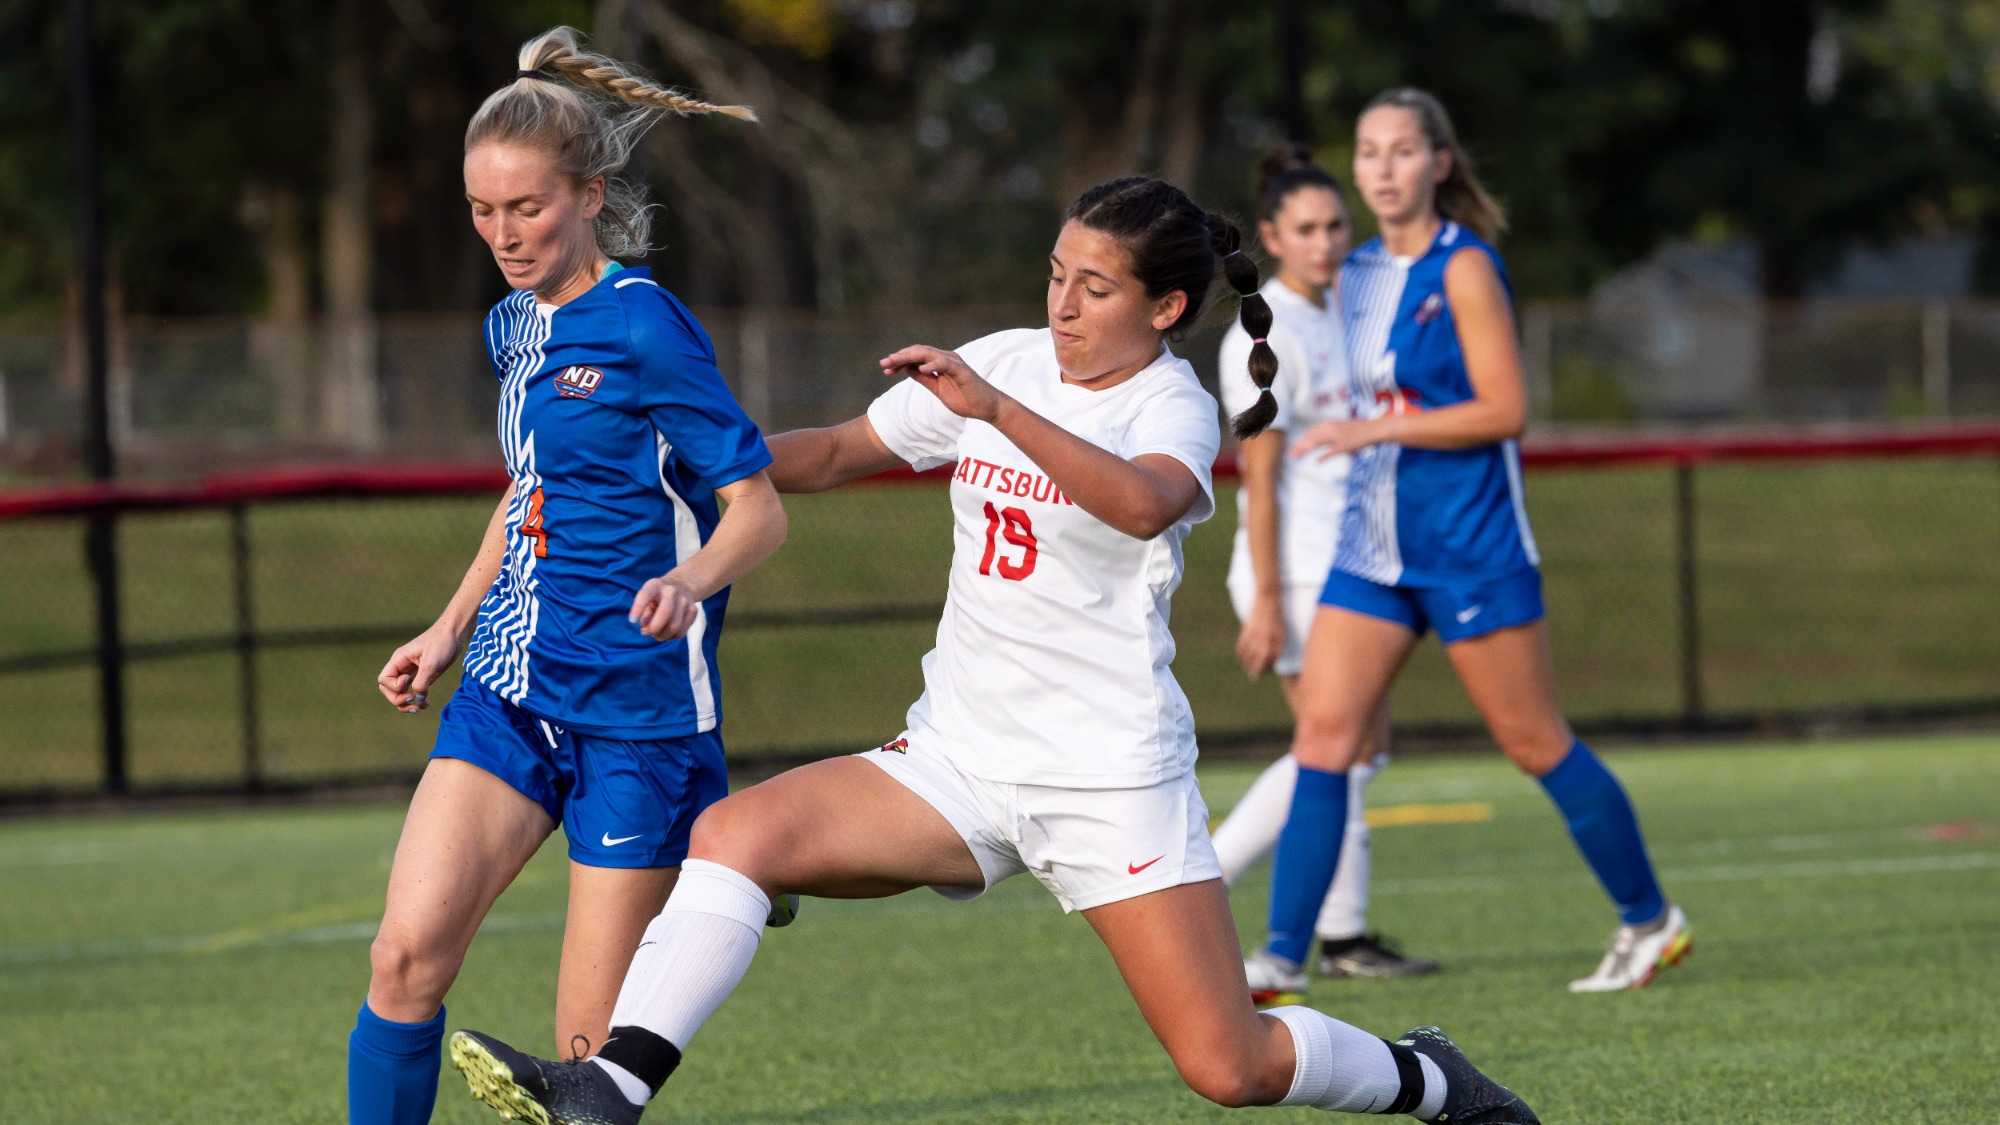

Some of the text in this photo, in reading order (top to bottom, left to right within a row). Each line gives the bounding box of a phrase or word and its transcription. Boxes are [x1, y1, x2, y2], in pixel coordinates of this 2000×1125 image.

[562, 366, 601, 388] NP
[953, 456, 1073, 506] ATTSBU
[520, 486, 548, 558] 4
[979, 501, 1038, 581] 19
